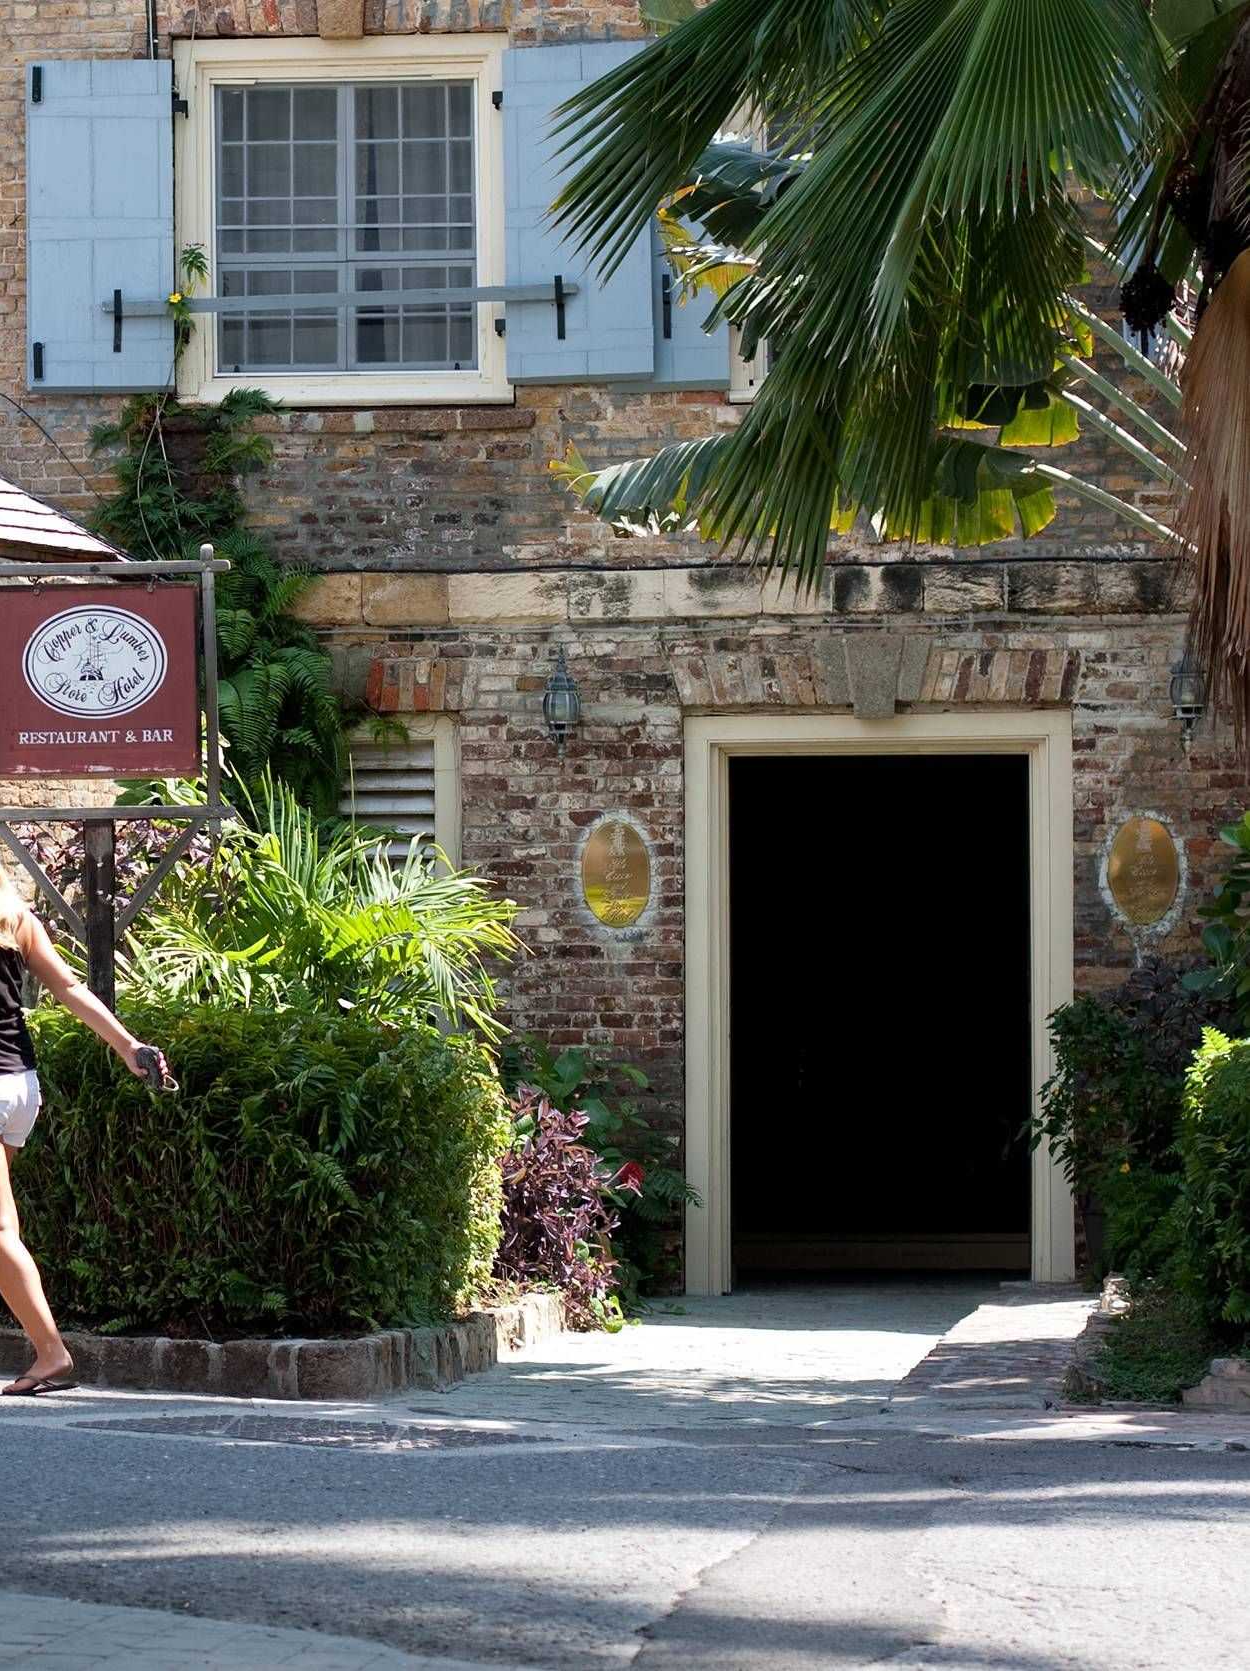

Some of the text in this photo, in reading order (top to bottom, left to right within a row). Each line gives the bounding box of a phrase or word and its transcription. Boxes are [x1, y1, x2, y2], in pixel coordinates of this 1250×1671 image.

[36, 618, 151, 664] Copper & Lumber
[44, 667, 145, 707] Store Hotel
[18, 729, 174, 745] RESTAURANT & BAR
